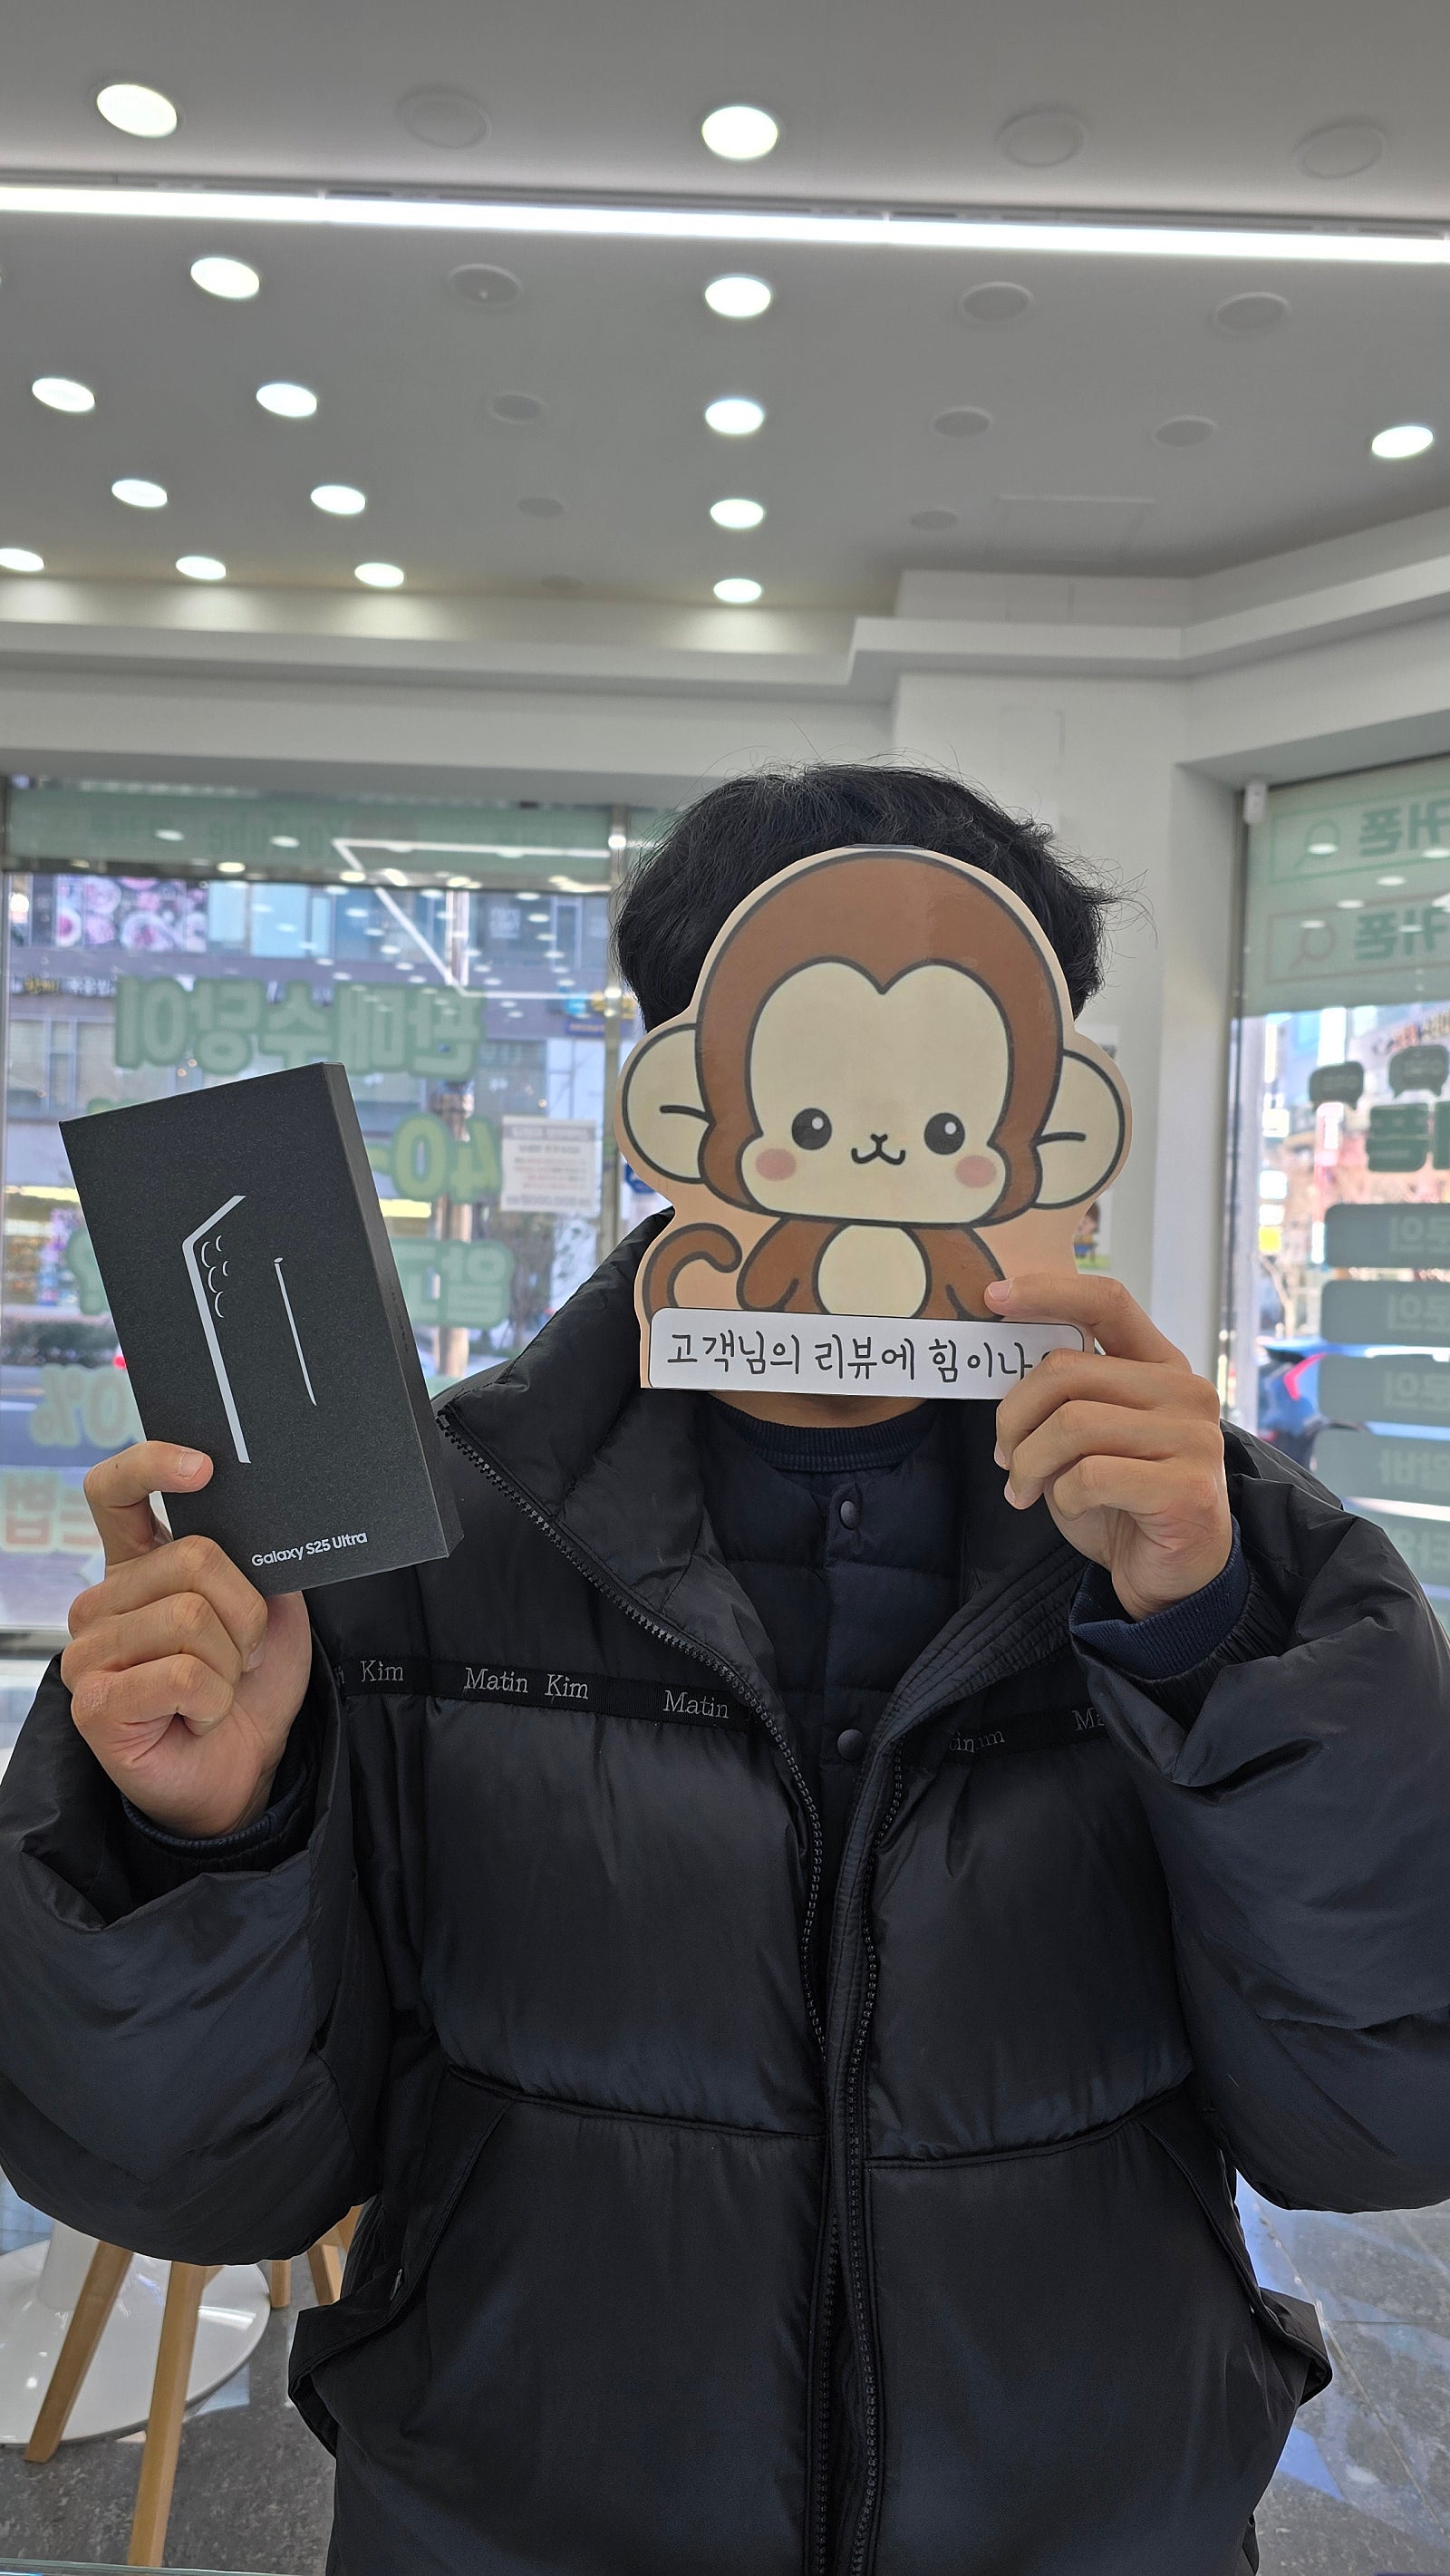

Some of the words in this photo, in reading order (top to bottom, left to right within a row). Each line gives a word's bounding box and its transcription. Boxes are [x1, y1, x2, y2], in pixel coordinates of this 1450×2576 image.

[667, 1329, 799, 1375] 고객님의
[815, 1333, 914, 1380] 리뷰에
[928, 1338, 1051, 1383] 힘이나
[251, 1546, 304, 1566] Galaxy
[305, 1538, 332, 1554] S25
[332, 1532, 368, 1549] Ultra
[360, 1660, 404, 1683] Kim
[463, 1667, 529, 1694] Matin
[544, 1673, 589, 1700] Kim
[662, 1690, 730, 1719] Matin
